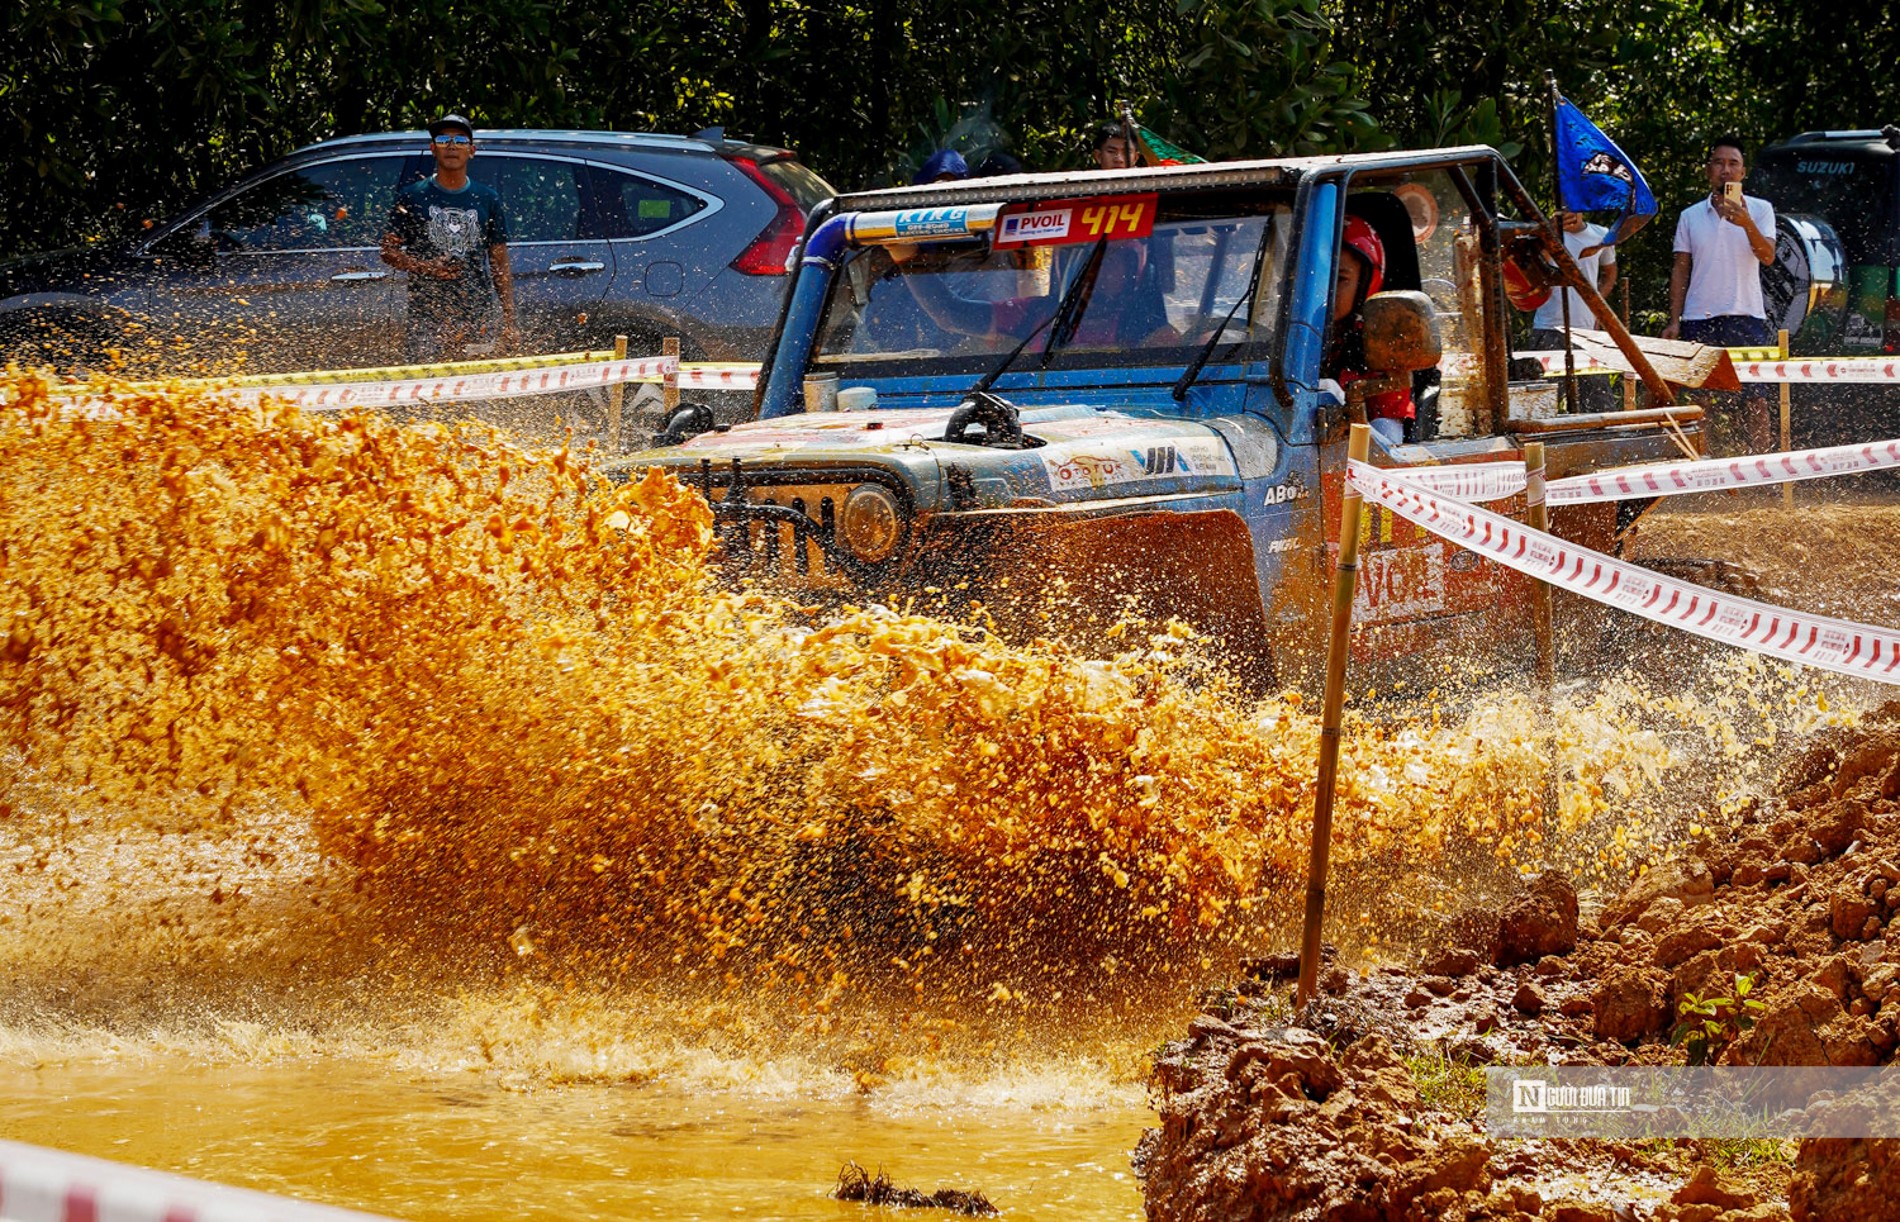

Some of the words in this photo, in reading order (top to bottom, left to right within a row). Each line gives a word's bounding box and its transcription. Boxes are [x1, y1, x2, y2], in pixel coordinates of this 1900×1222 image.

[1796, 160, 1855, 175] SUZUKI
[898, 208, 964, 223] KING
[1020, 213, 1065, 230] PVOIL
[1080, 202, 1145, 236] 414
